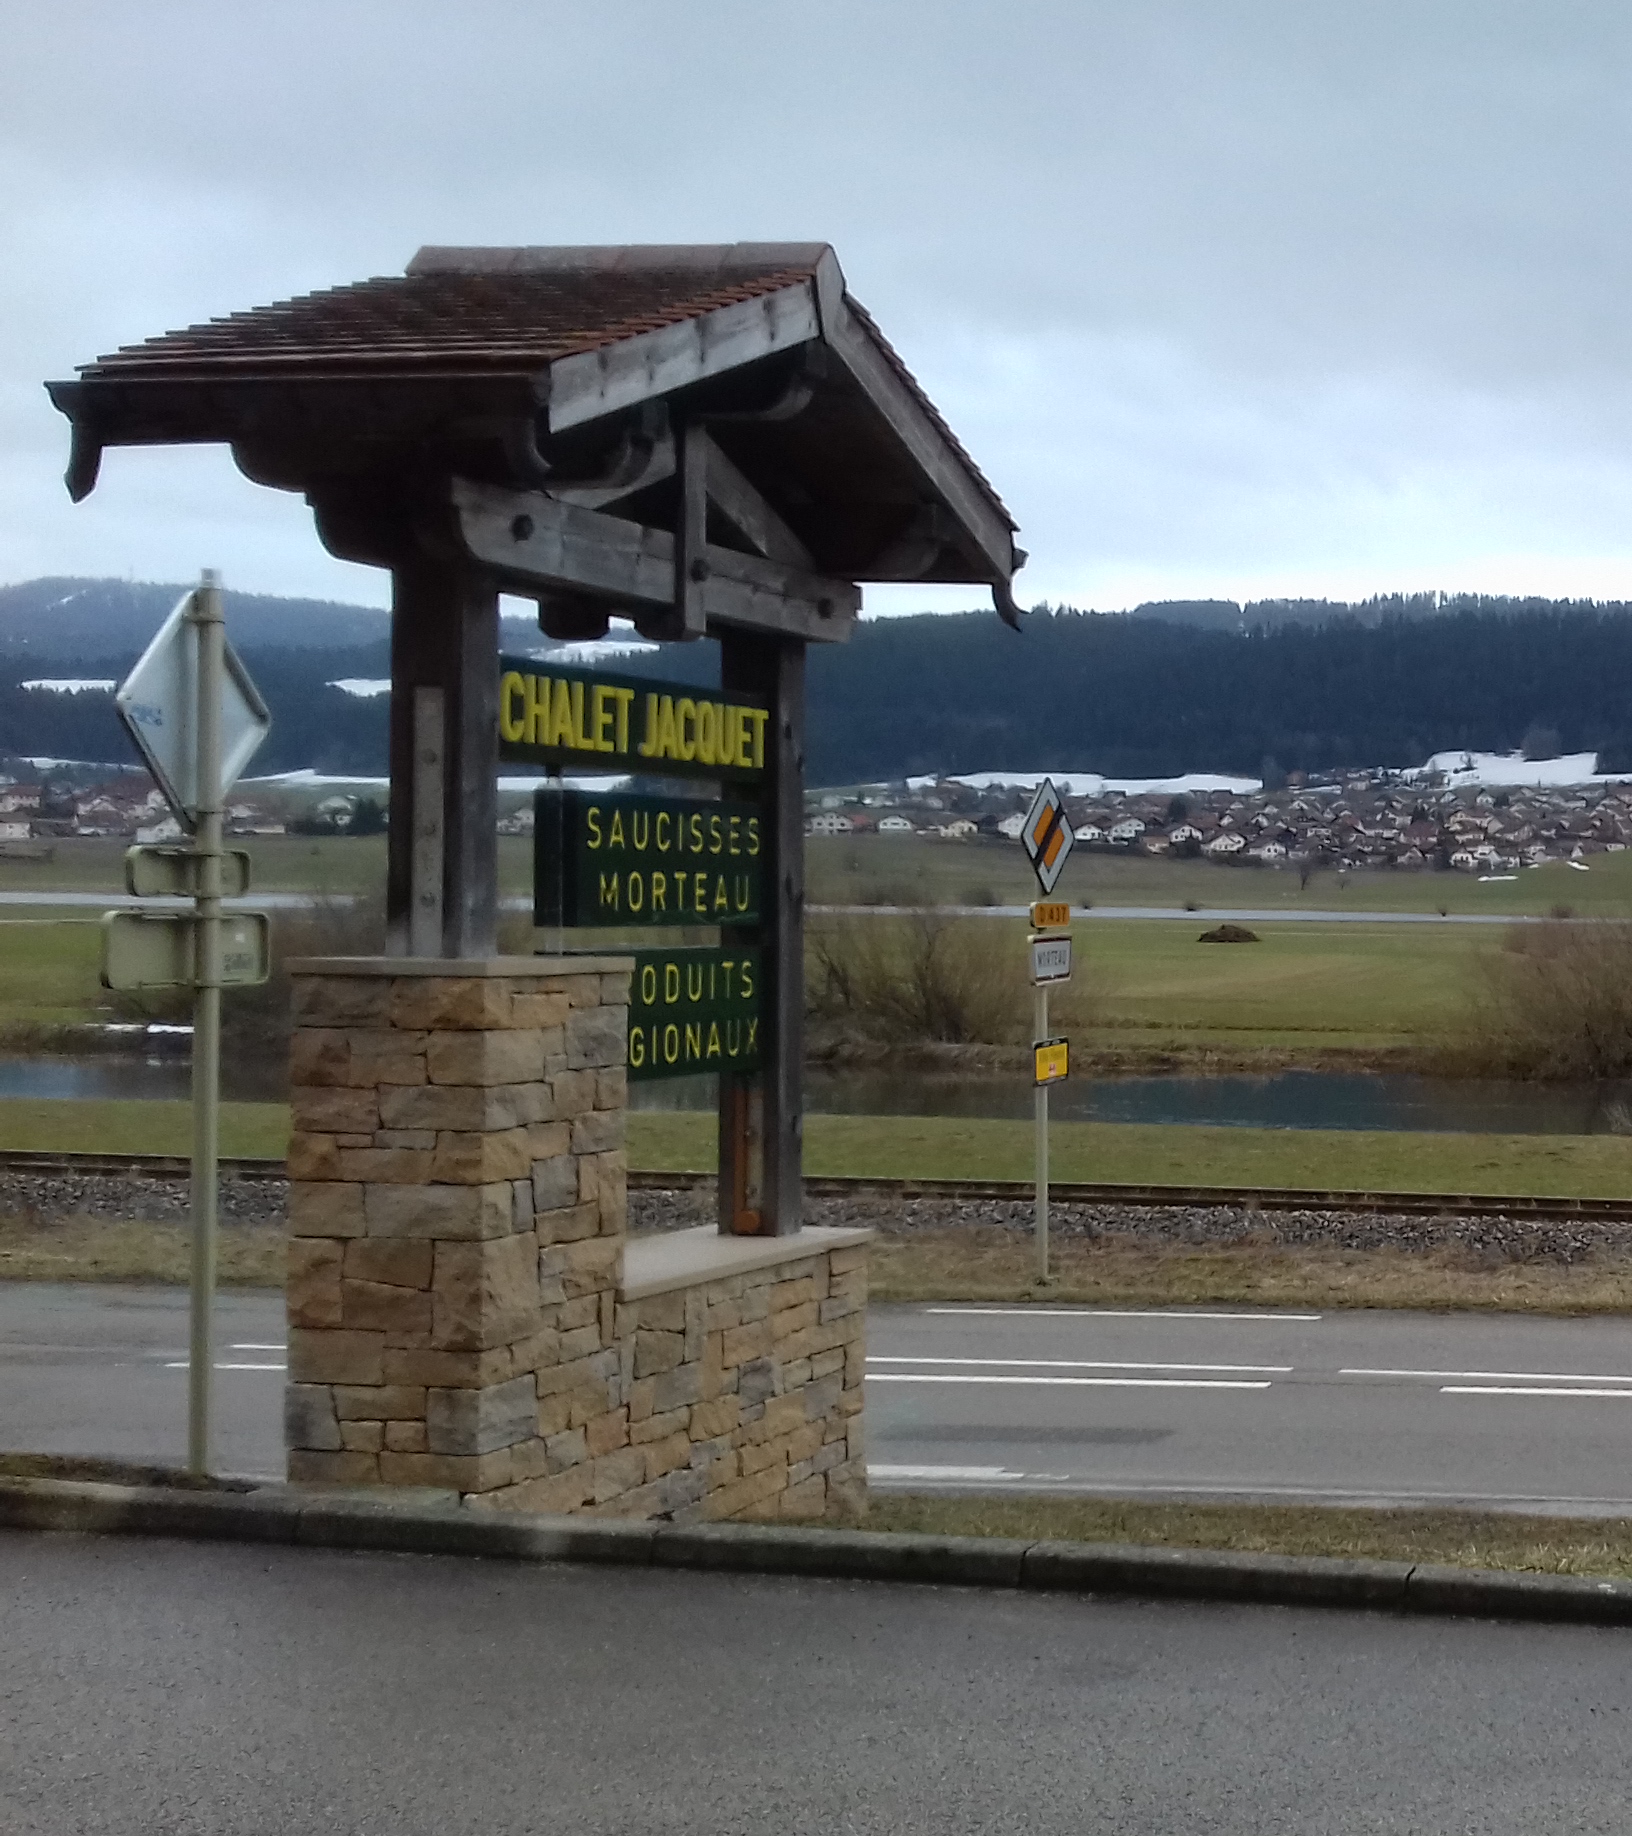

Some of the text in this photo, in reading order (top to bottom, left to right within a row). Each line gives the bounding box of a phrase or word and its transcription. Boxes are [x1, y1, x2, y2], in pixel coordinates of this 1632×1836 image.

[500, 671, 770, 769] CHALET JACQUET
[586, 806, 761, 856] SAUCISSES
[599, 872, 751, 912] MORTEAU
[640, 960, 755, 1006] ODUITS
[629, 1016, 759, 1067] GIONAUX
